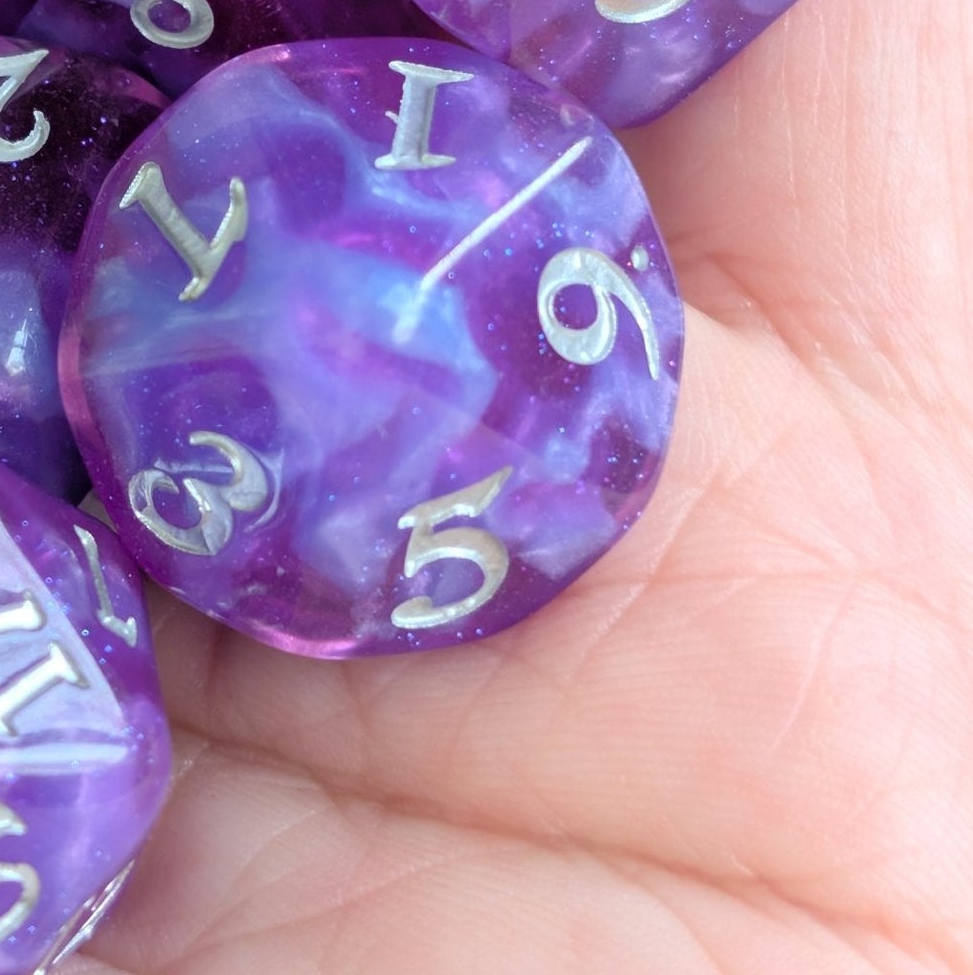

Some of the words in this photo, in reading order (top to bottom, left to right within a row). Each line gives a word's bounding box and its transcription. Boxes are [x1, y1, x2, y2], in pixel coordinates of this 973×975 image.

[374, 59, 474, 170] 1
[119, 161, 248, 302] 7
[128, 431, 270, 556] 3
[390, 466, 513, 630] 5
